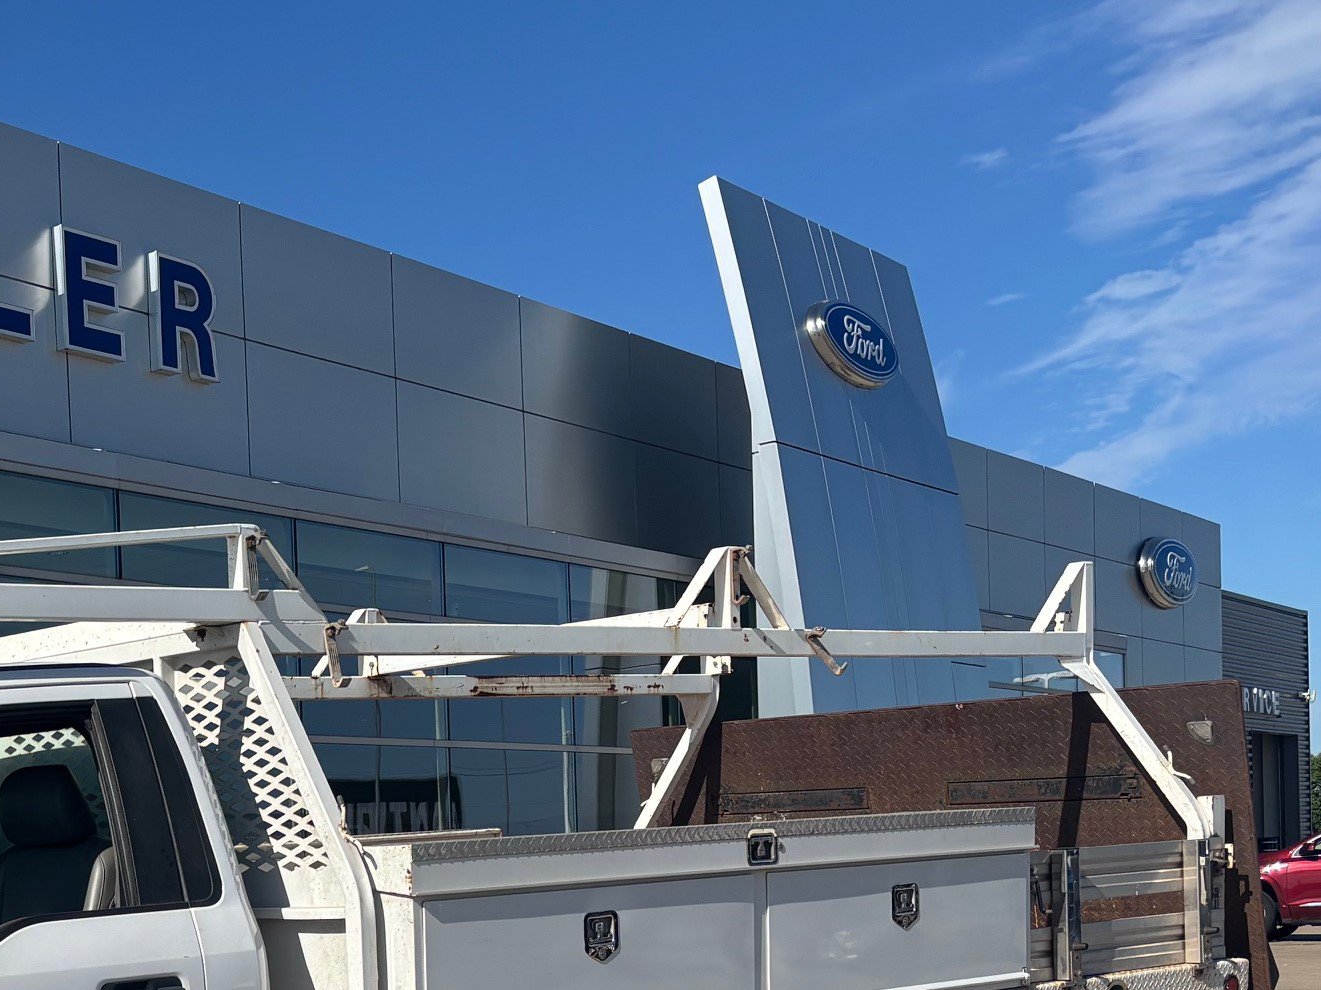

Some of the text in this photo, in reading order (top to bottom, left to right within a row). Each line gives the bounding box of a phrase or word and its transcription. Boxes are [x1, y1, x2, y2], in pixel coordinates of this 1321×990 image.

[842, 314, 887, 367] Ford
[1164, 551, 1193, 592] Ford
[1241, 686, 1281, 716] RVICE
